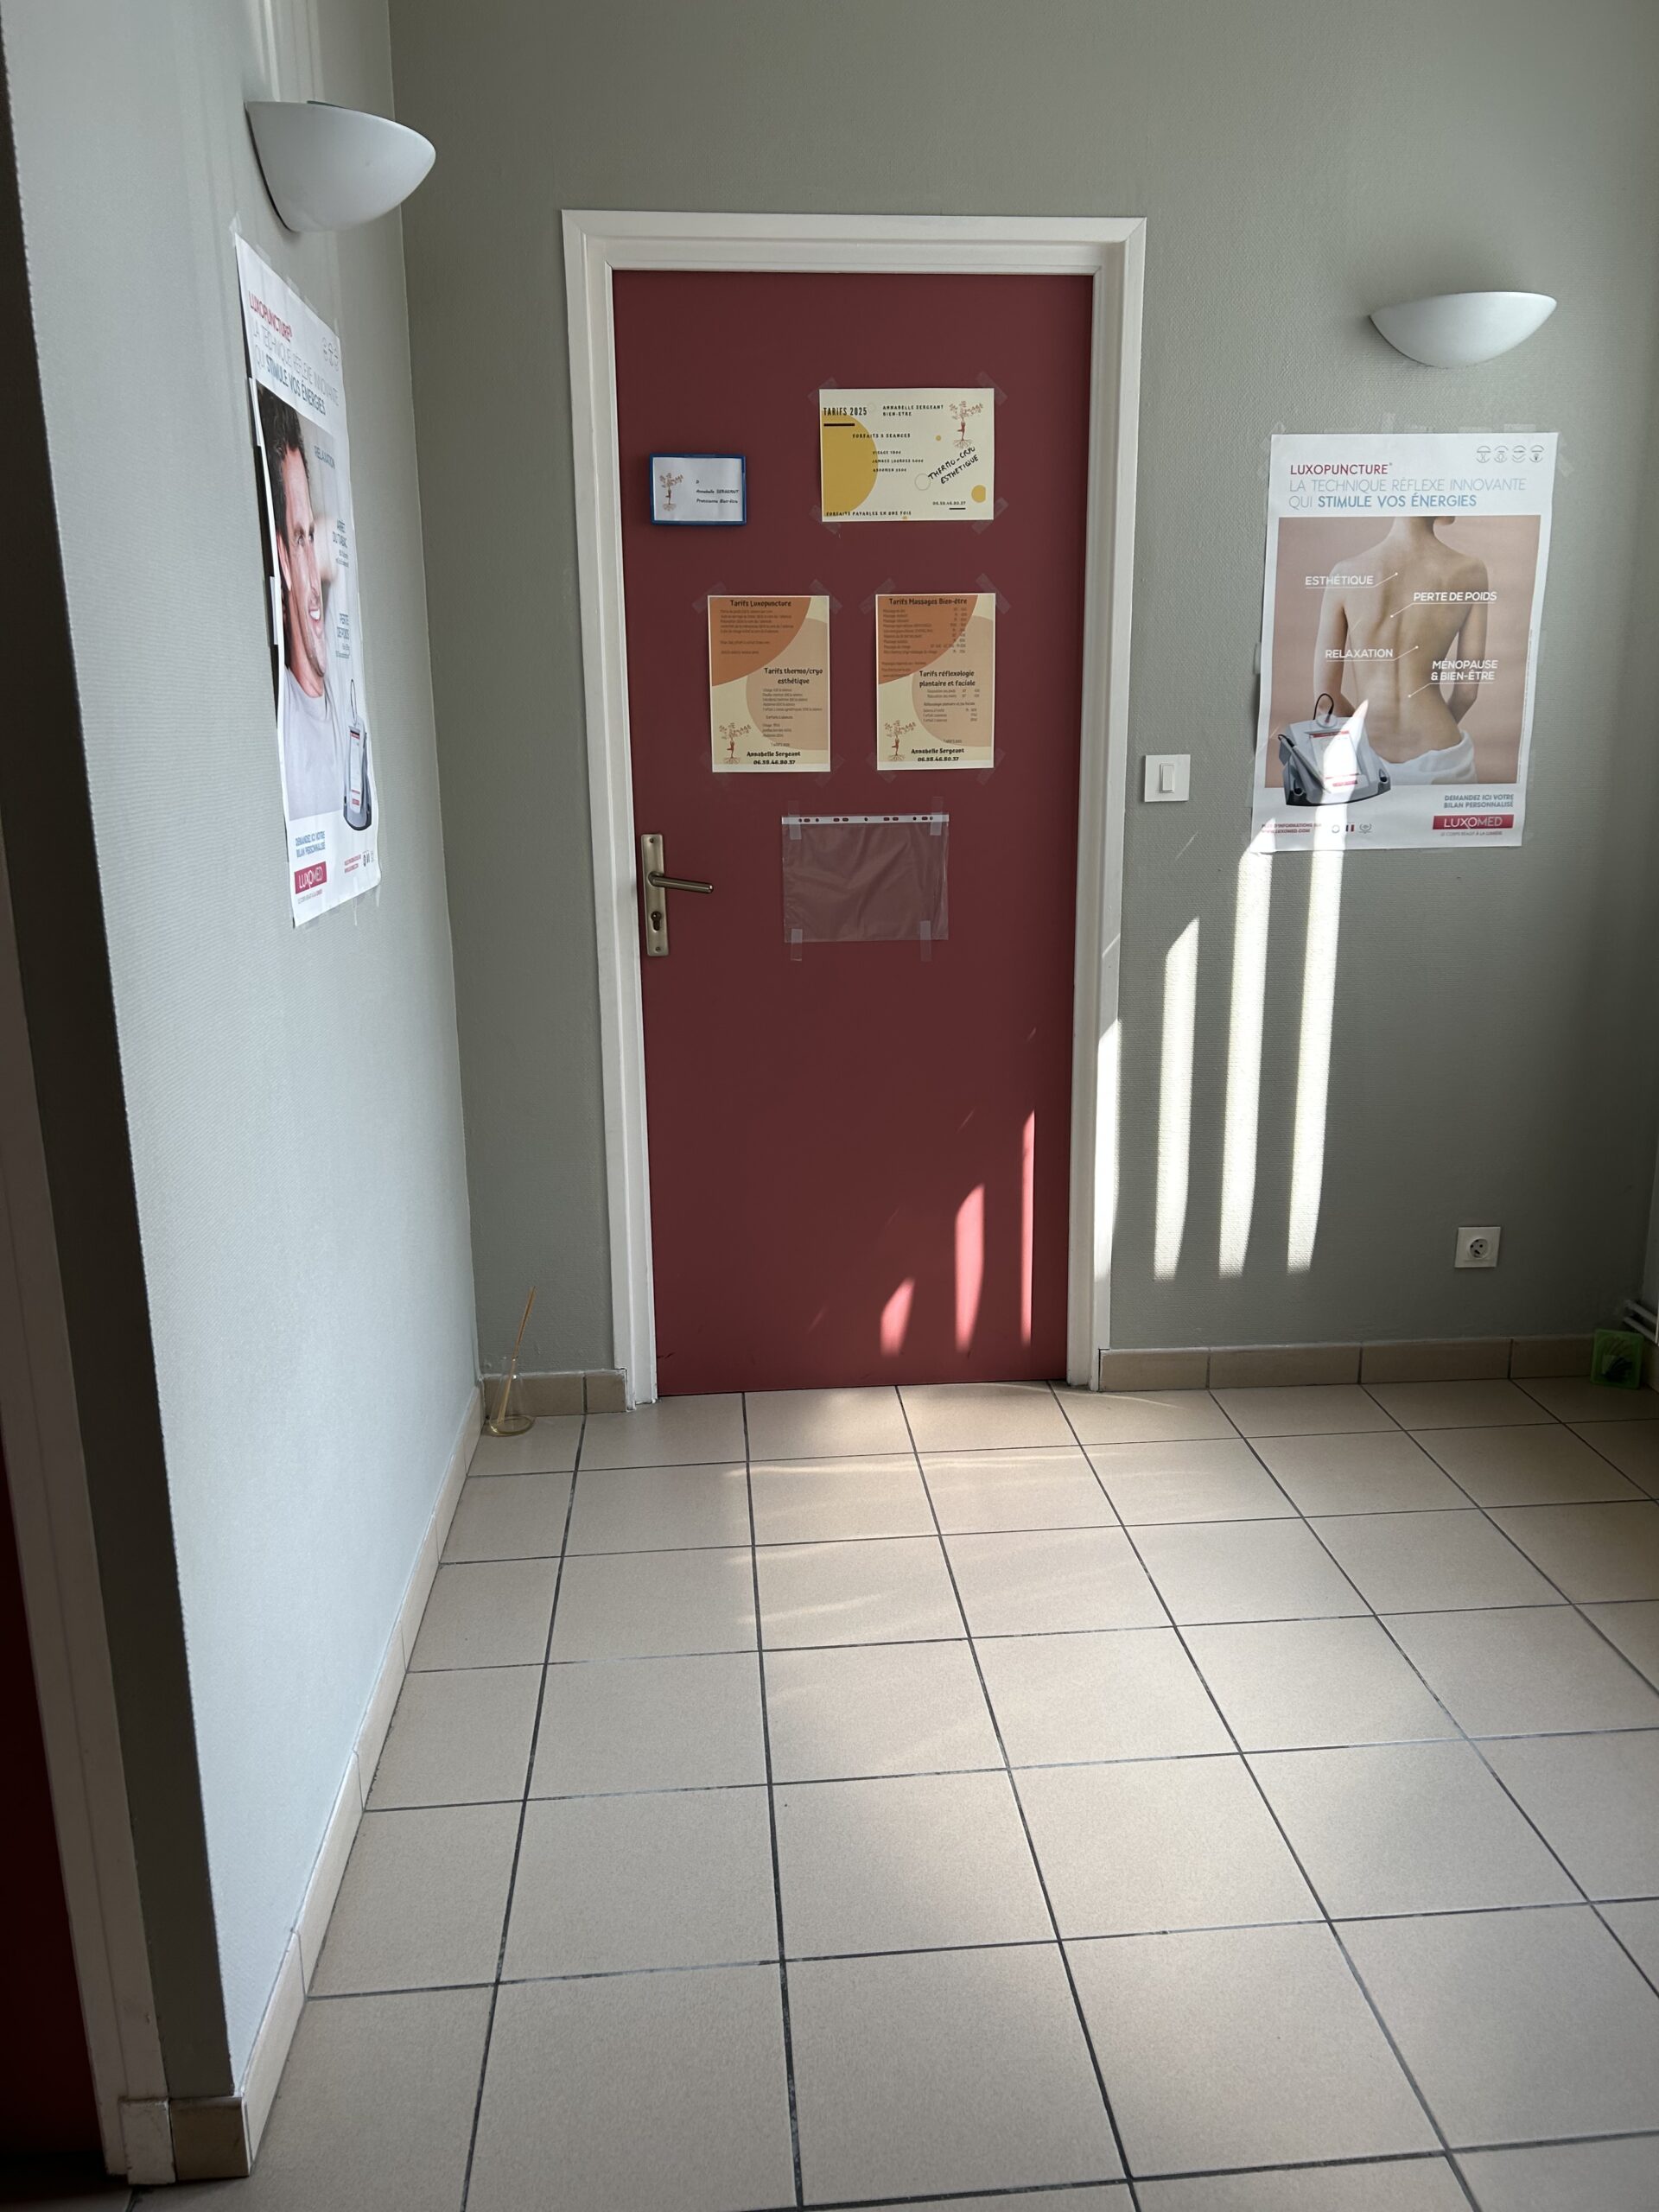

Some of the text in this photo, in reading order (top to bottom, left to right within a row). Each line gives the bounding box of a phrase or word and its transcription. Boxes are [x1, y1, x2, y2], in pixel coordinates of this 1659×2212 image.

[823, 407, 868, 416] TARIFS 2025
[940, 454, 978, 484] ESTHETIQUE
[1289, 477, 1527, 495] LA TECHNIQUE RÉFLEXE INNOVANTE
[1288, 493, 1477, 510] QUI STIMULE VOS ÉNERGIES
[1306, 574, 1374, 586] ESTHÉTIQUE
[1414, 591, 1497, 601] PERTE DE POIDS
[908, 598, 938, 607] Massages
[1325, 648, 1394, 658] RELAXATION
[1432, 658, 1498, 669] MÉNOPAUSE
[784, 667, 823, 676] thermo/cryo
[938, 670, 975, 678] réflexologie
[1431, 670, 1495, 681] & BIEN-ÊTRE
[1444, 817, 1503, 829] LUXOMED
[299, 867, 323, 889] LUXOMED
